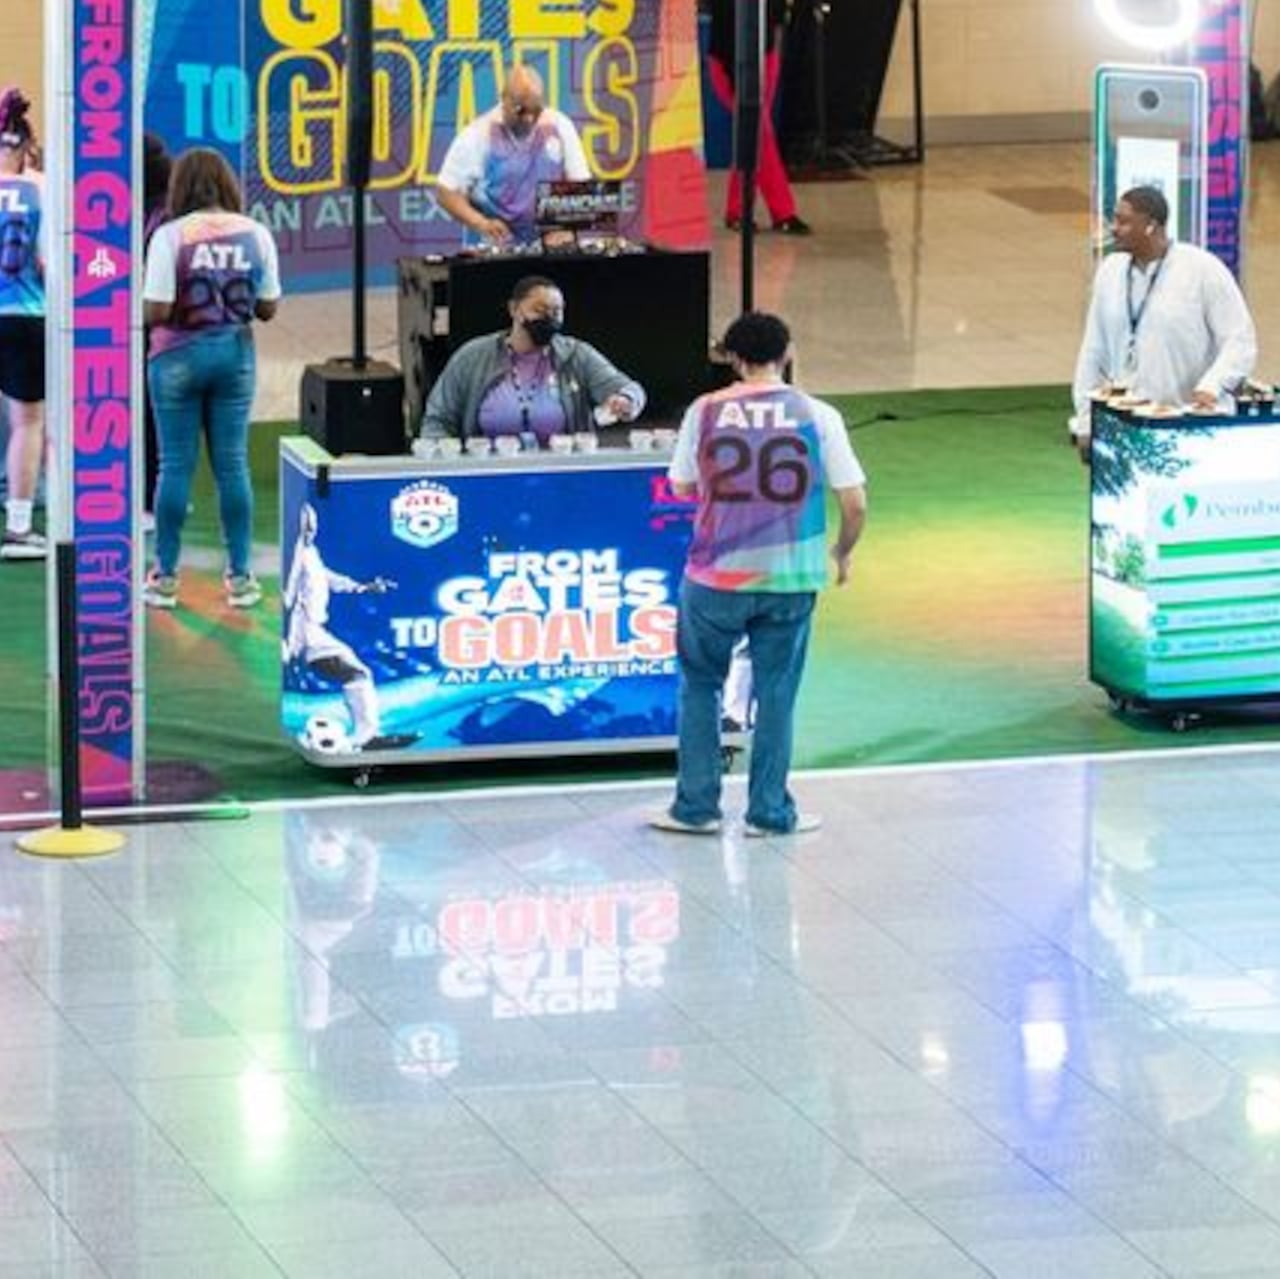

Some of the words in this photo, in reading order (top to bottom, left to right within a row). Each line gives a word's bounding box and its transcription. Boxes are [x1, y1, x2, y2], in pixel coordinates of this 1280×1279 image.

[177, 64, 248, 141] TO
[250, 201, 300, 232] AN
[189, 245, 252, 270] ATL
[72, 169, 134, 455] GATES
[716, 401, 798, 429] ATL
[76, 462, 127, 524] TO
[704, 435, 809, 504] 26
[489, 548, 619, 580] FROM
[438, 568, 670, 615] GATES
[78, 532, 135, 736] GOALS
[390, 617, 436, 648] TO
[437, 606, 678, 667] GOALS
[442, 668, 481, 684] AN
[485, 666, 532, 682] ATL
[538, 658, 677, 681] EXPERIENCE
